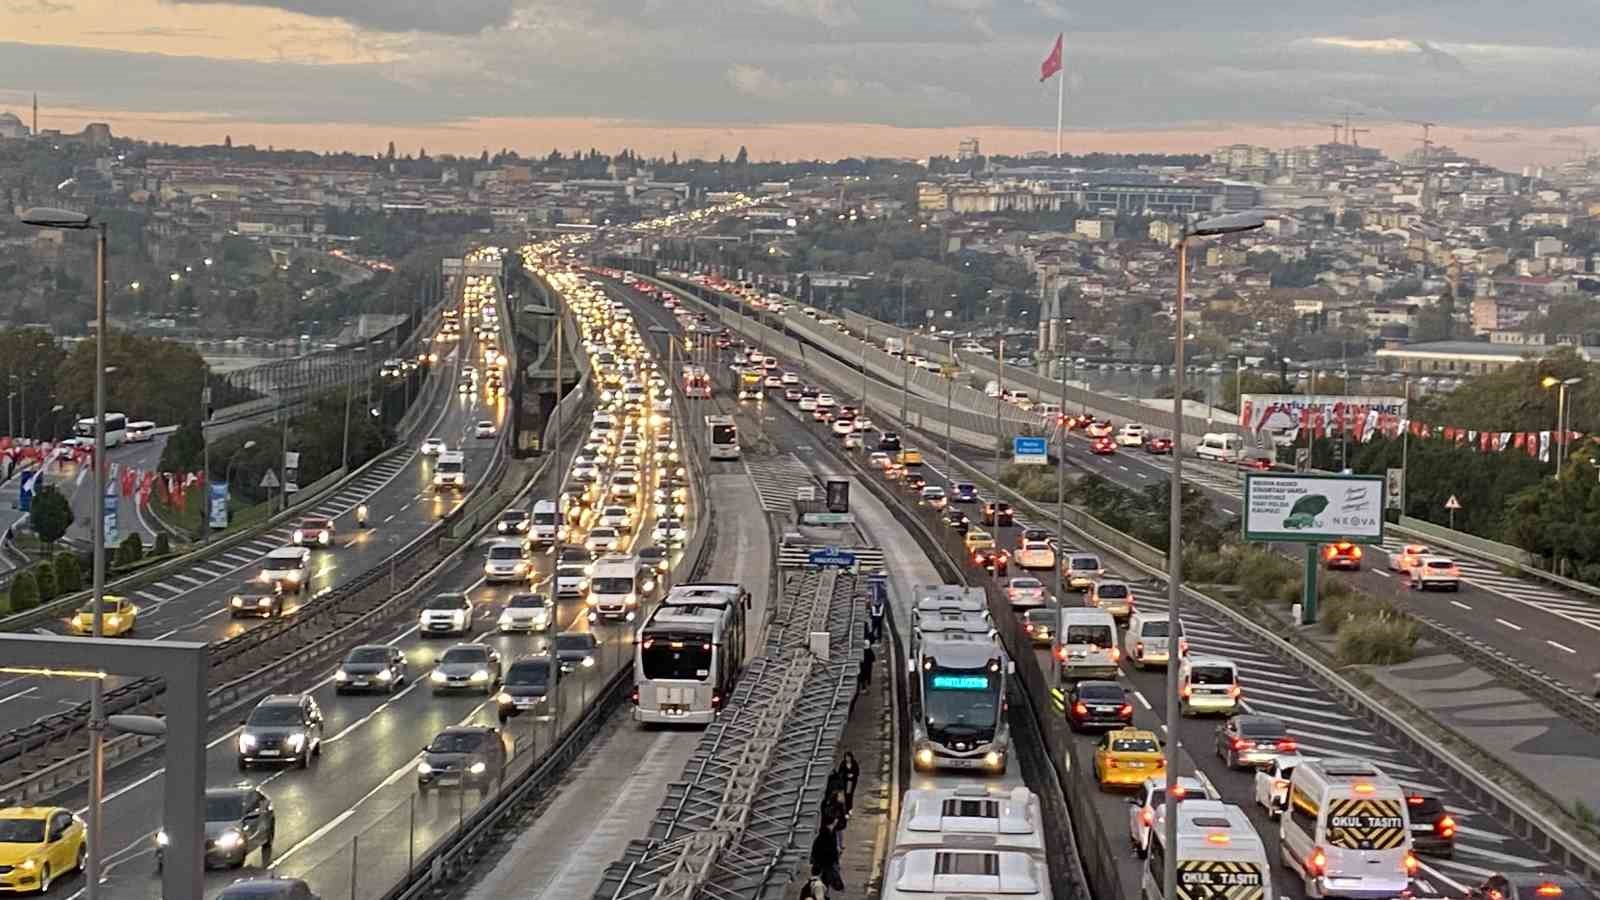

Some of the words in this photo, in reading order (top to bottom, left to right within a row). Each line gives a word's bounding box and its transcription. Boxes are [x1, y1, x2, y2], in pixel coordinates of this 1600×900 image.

[1332, 516, 1376, 526] NEOVA
[1332, 816, 1362, 827] OKUL
[1182, 872, 1214, 884] OKUL
